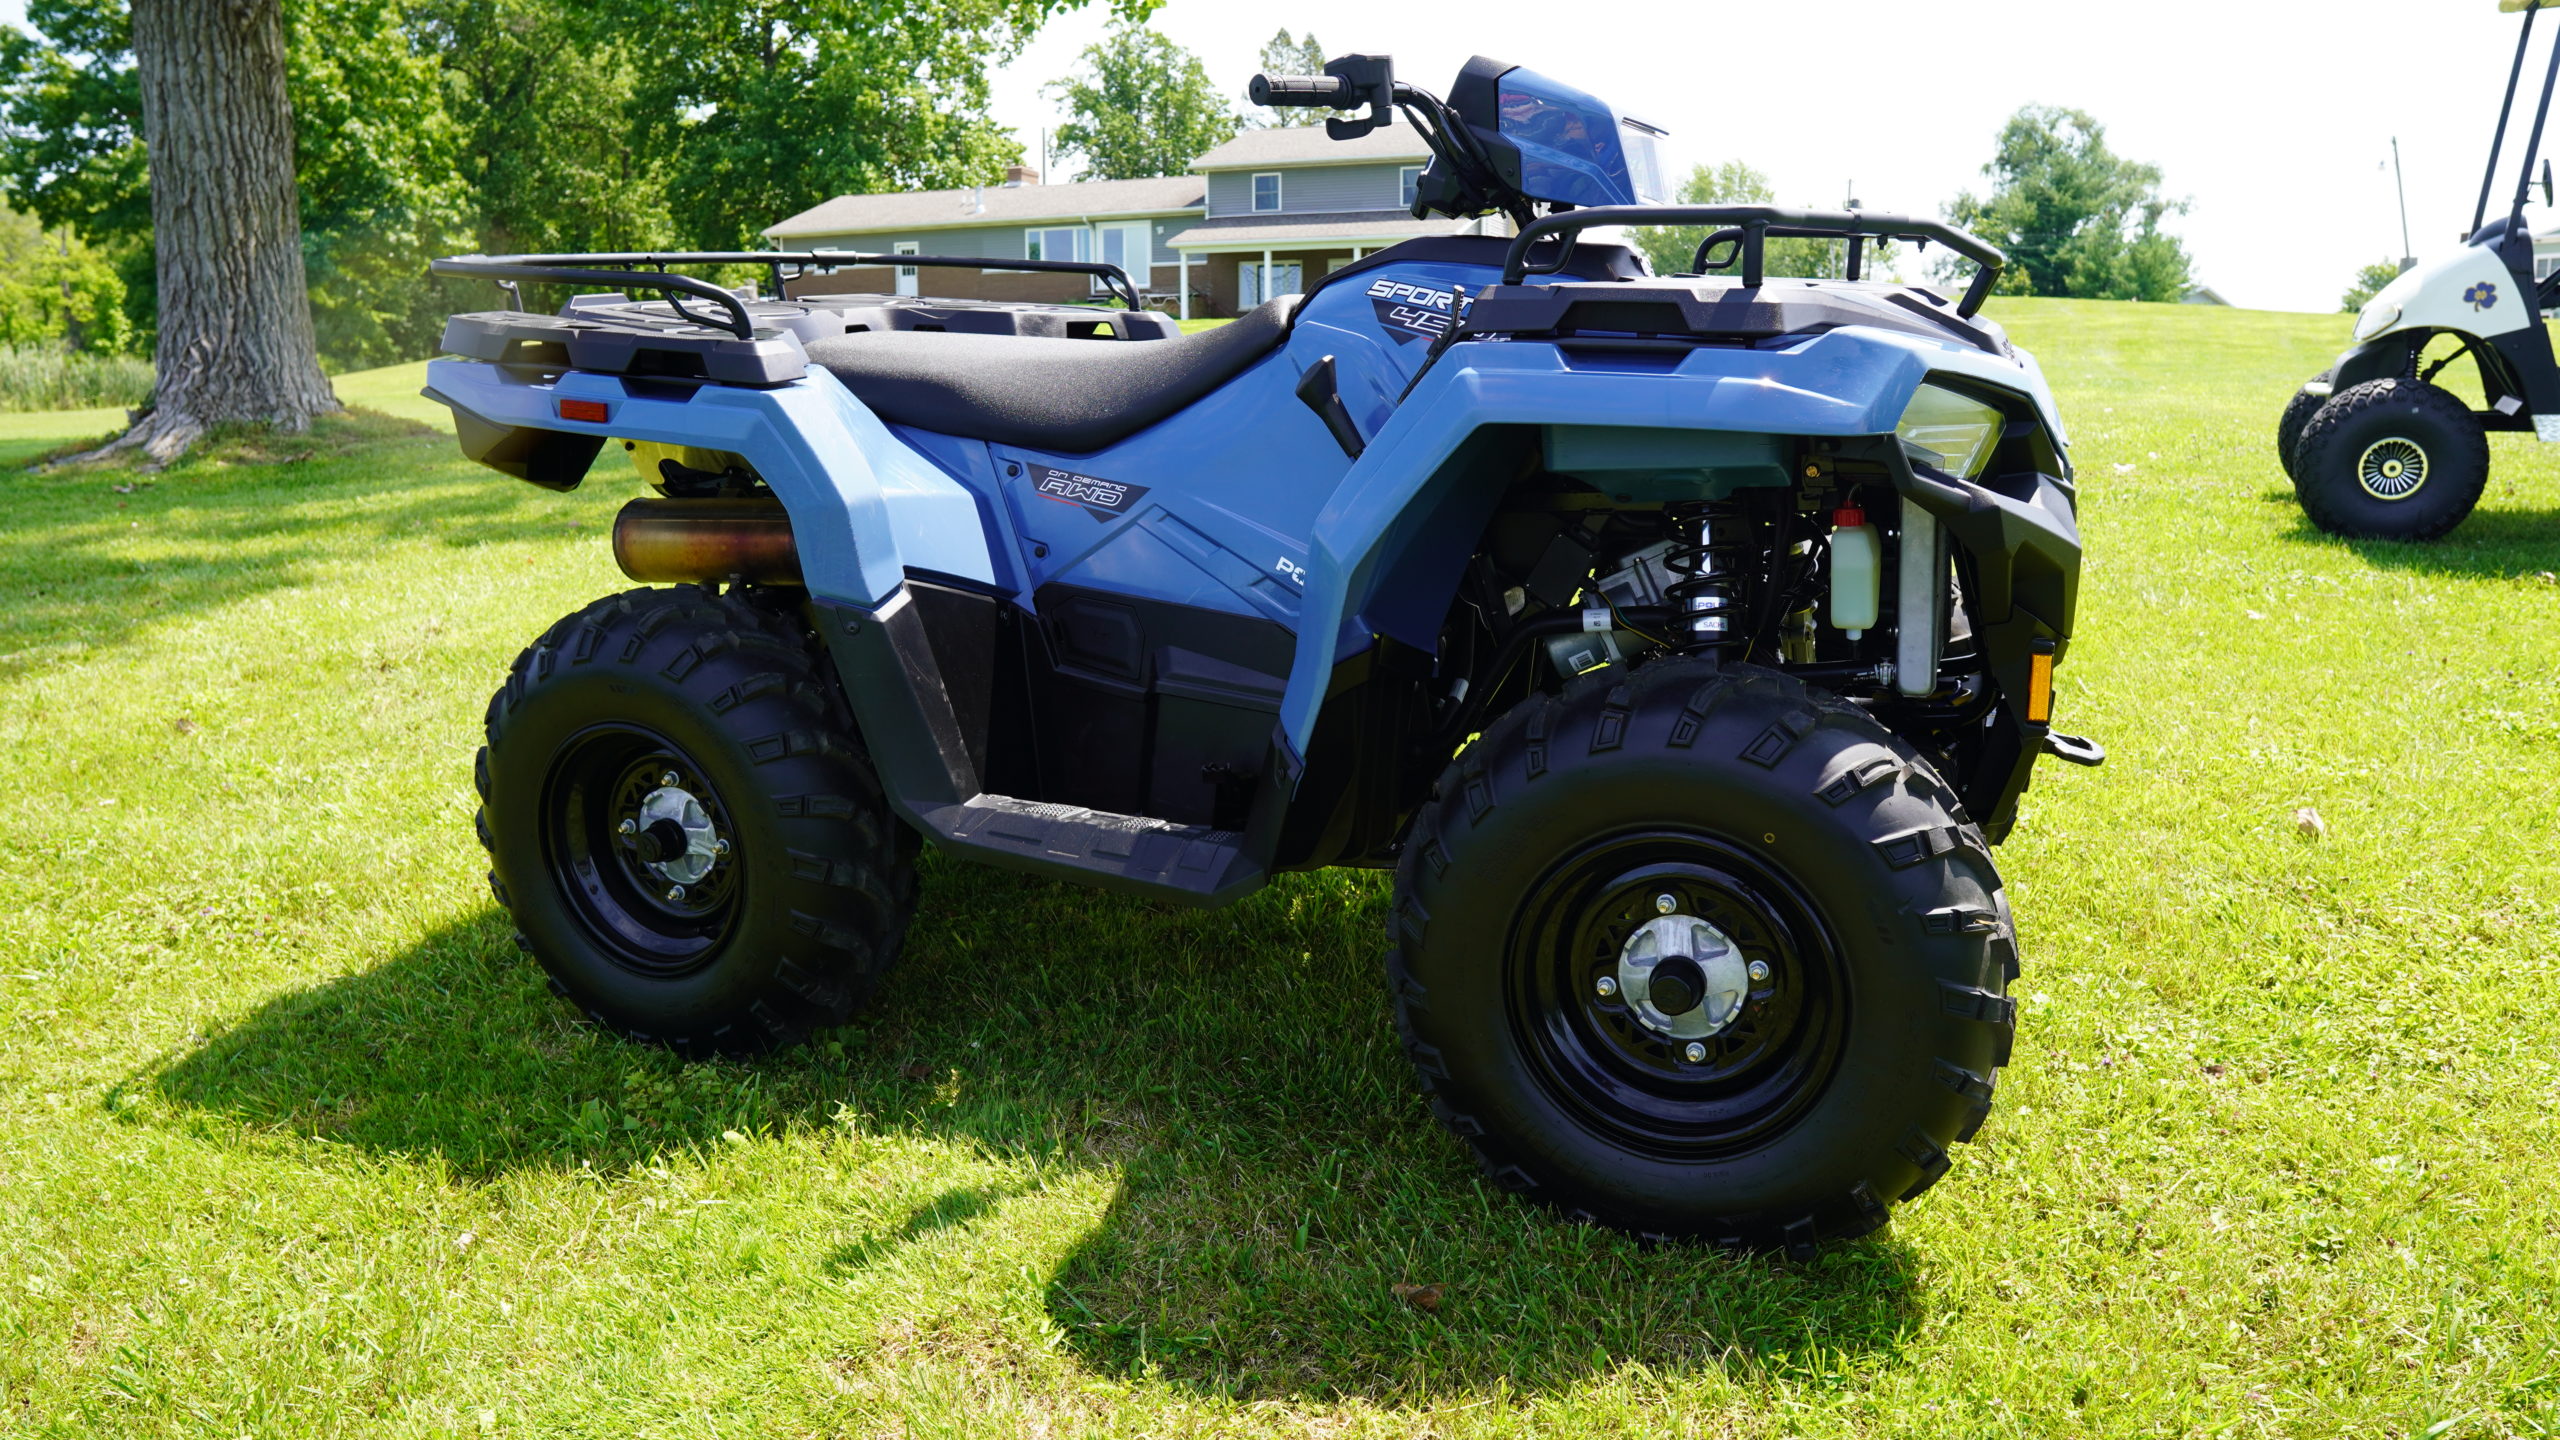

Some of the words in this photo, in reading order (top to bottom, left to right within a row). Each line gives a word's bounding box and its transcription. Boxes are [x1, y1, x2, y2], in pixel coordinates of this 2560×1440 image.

[1039, 477, 1123, 507] AWD
[1048, 469, 1069, 479] ON
[1072, 475, 1128, 492] DEMAND
